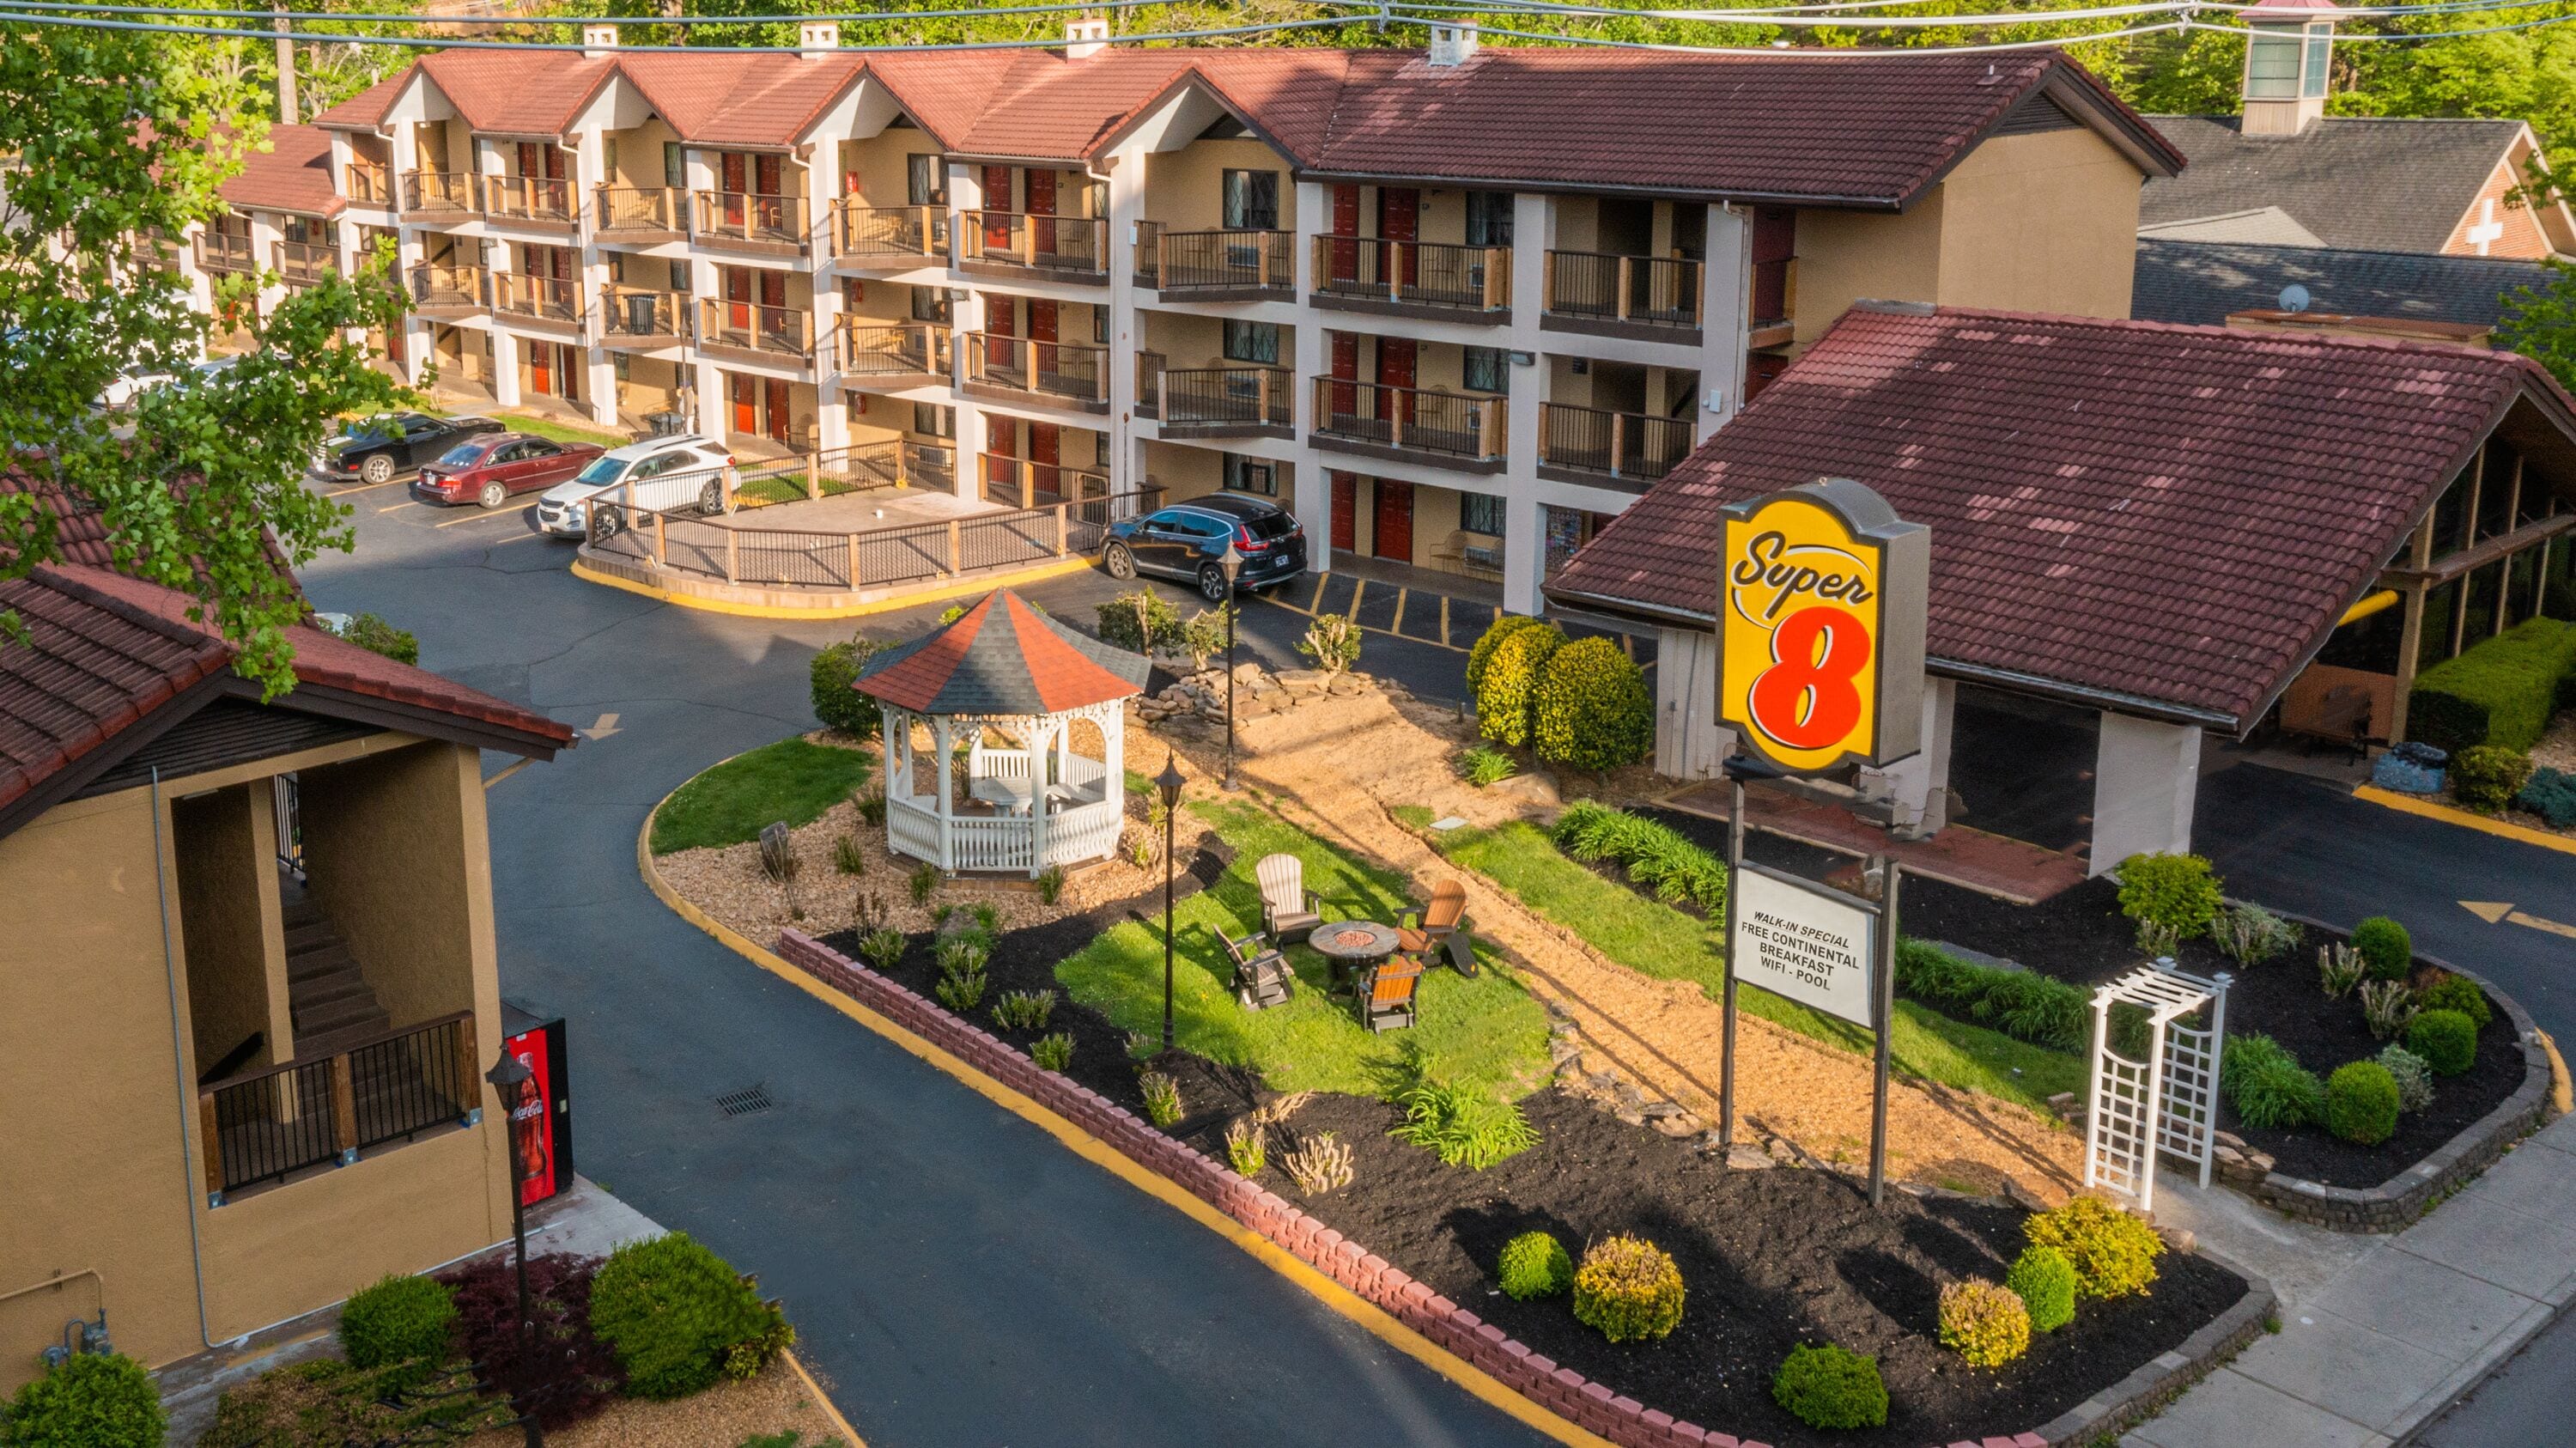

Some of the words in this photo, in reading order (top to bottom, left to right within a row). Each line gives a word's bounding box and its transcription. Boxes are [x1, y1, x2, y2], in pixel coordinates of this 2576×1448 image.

[1730, 530, 1874, 621] Super
[1747, 605, 1871, 751] 8
[1741, 921, 1769, 940] FREE
[1771, 931, 1860, 970] CONTINENTAL
[1753, 910, 1799, 933] WALK-IN
[1800, 925, 1850, 949] SPECIAL
[1759, 941, 1835, 976] BREAKFAST
[1760, 955, 1786, 974] WIFI
[1796, 969, 1831, 991] POOL
